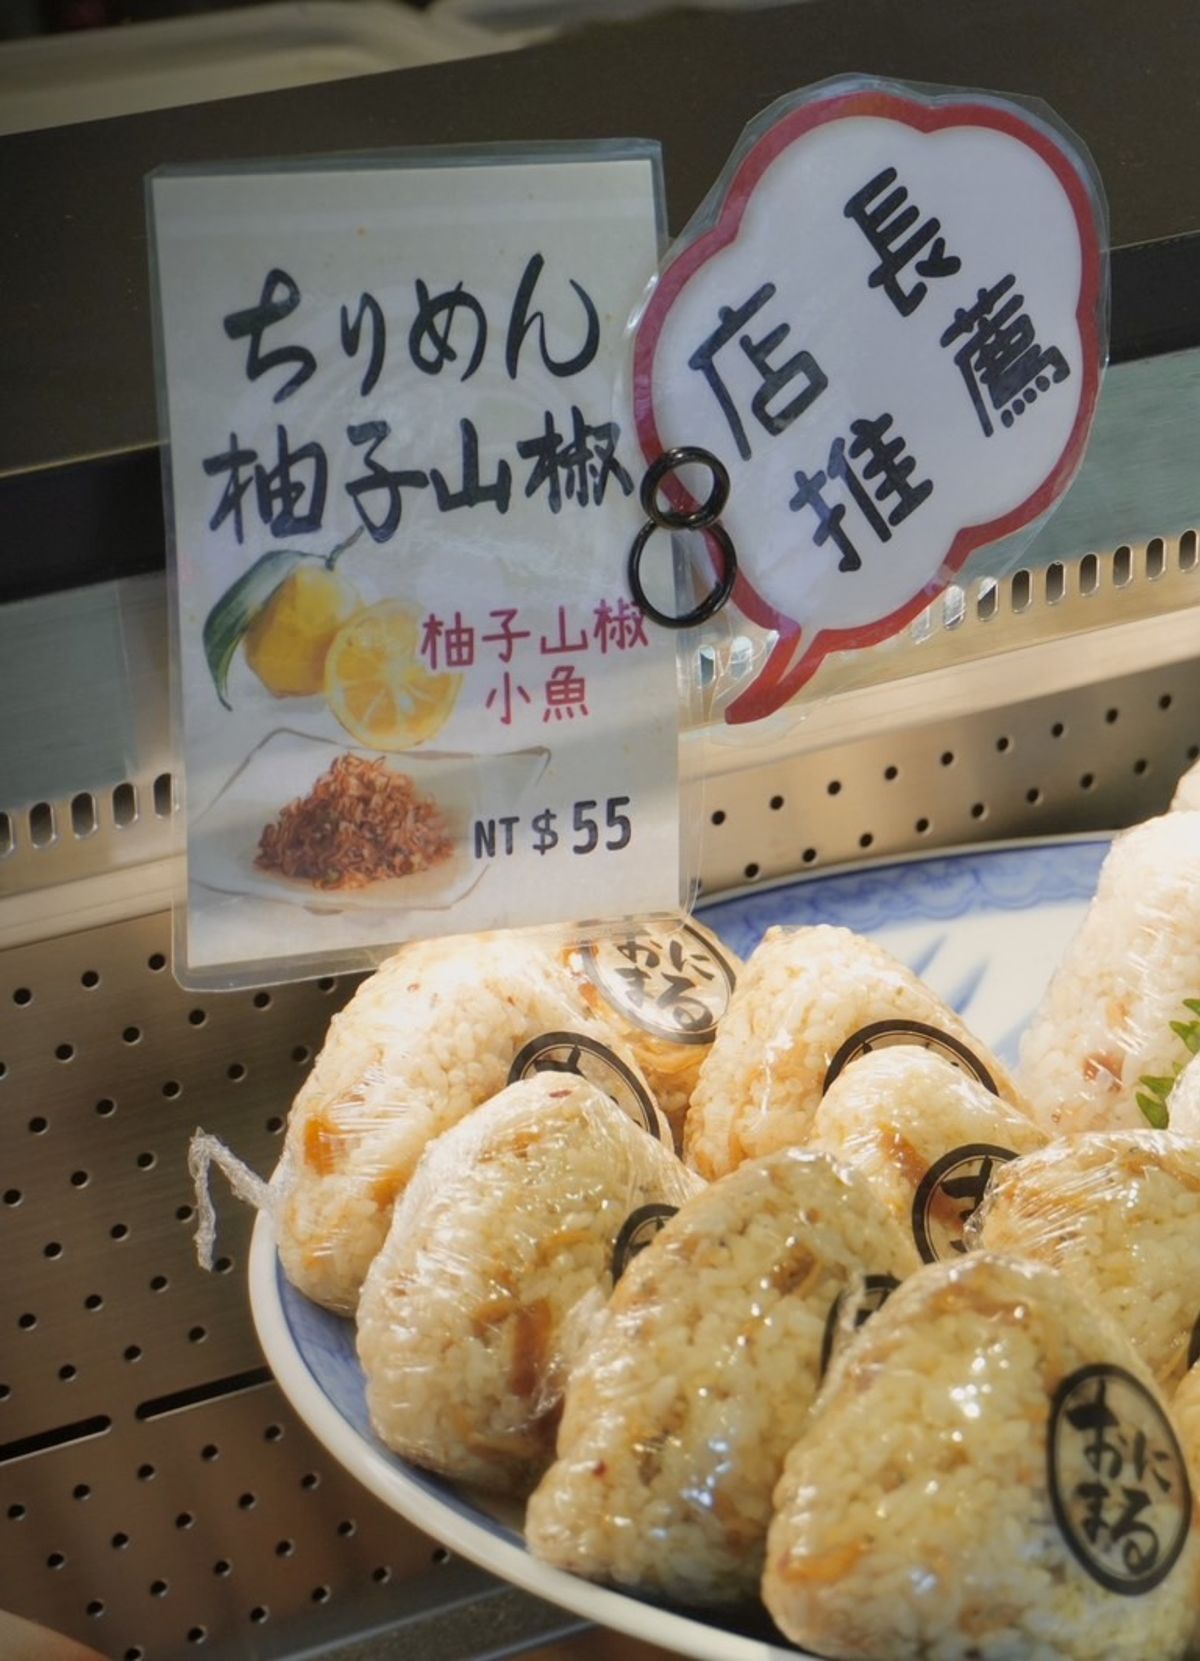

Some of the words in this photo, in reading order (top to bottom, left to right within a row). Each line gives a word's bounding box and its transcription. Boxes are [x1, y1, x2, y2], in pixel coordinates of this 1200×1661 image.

[224, 253, 600, 403] ちりめん
[203, 405, 635, 545] 柚子山椒
[420, 596, 649, 669] 柚子山椒
[485, 665, 589, 725] 小魚
